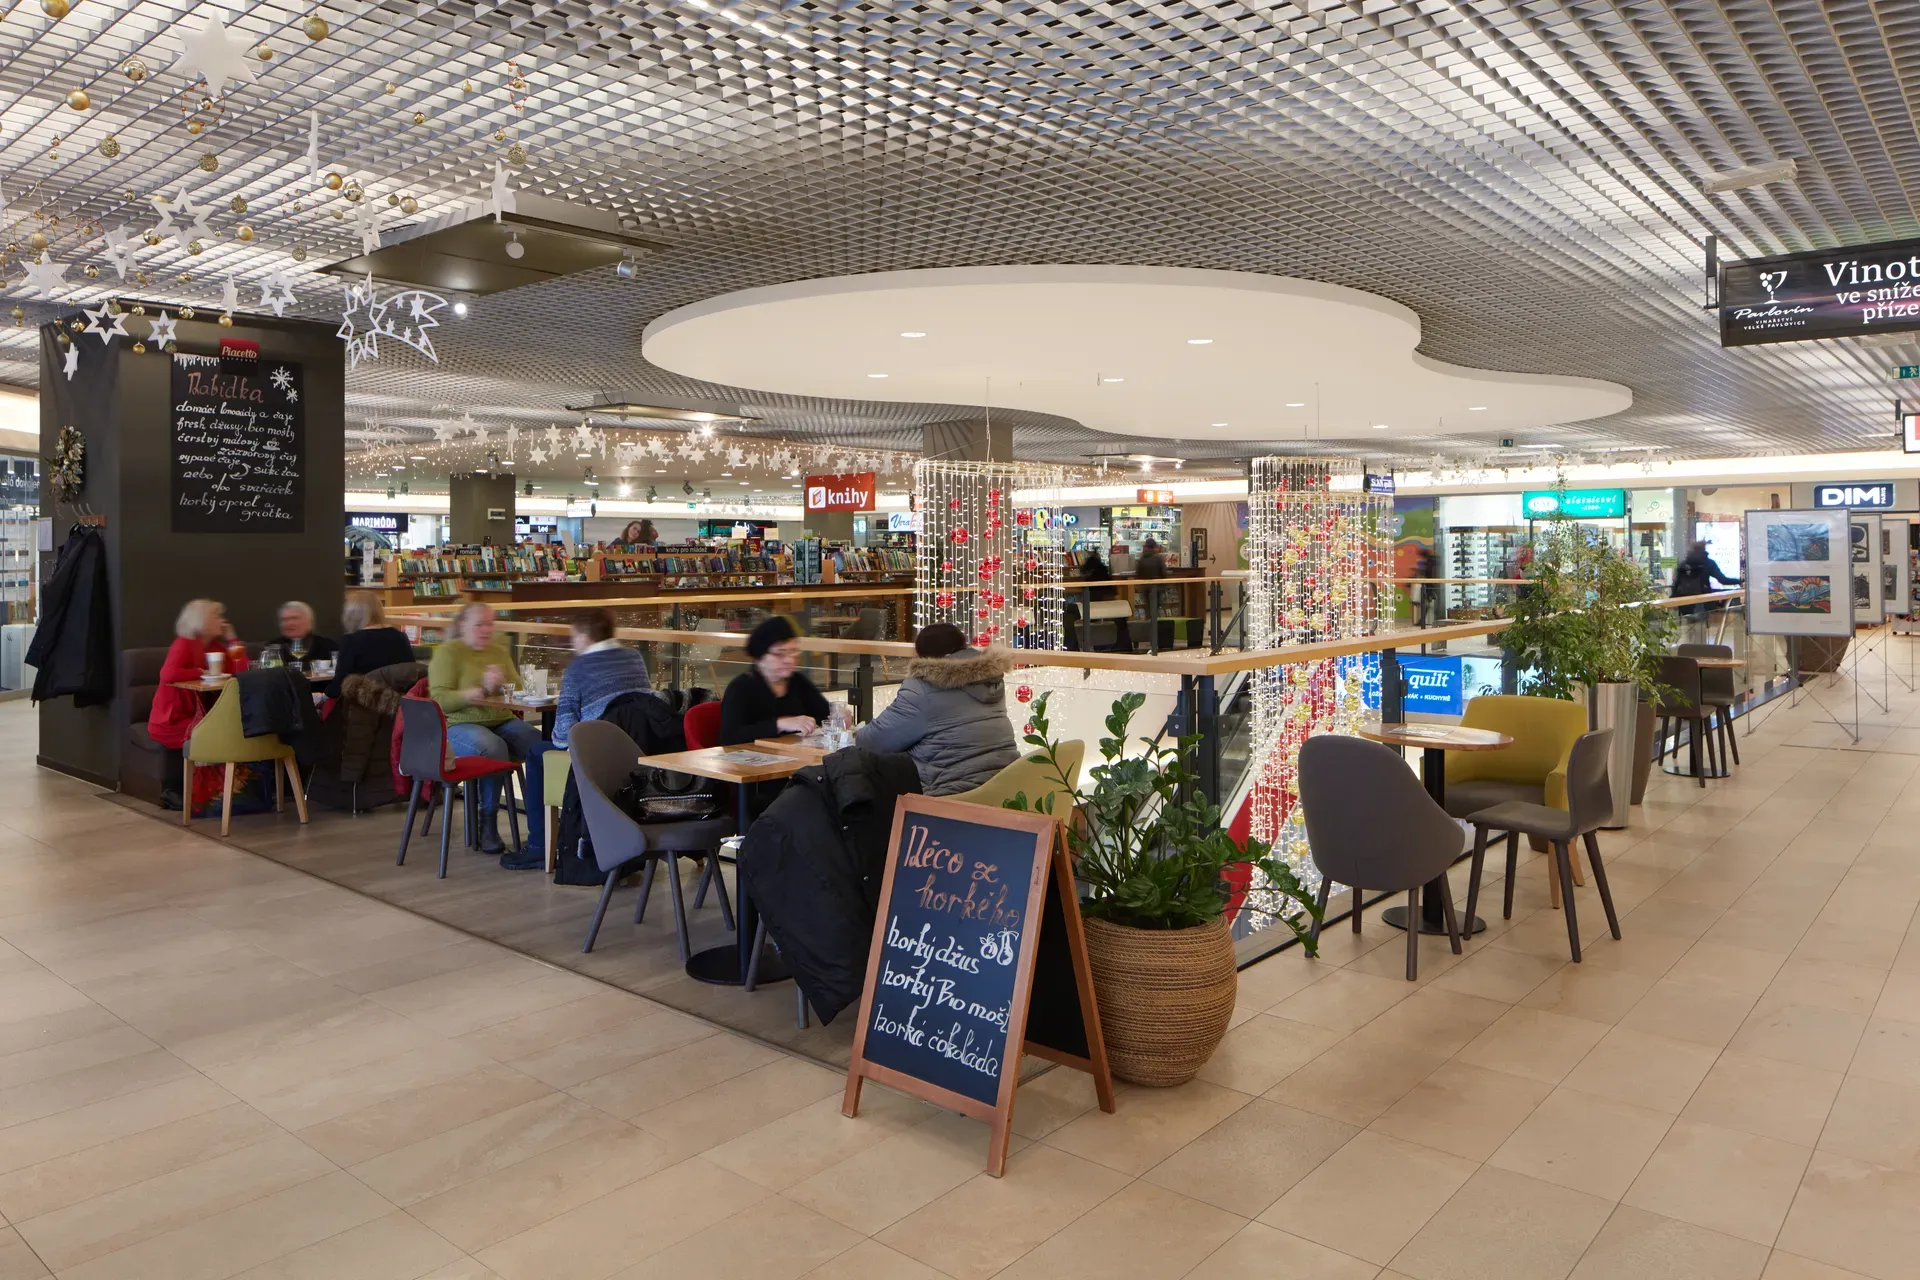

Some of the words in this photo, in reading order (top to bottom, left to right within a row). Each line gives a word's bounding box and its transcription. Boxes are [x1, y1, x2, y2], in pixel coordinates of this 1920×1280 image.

[1822, 256, 1920, 286] Vinot
[1836, 290, 1860, 304] ve
[1867, 280, 1920, 302] sníže
[1862, 300, 1920, 324] příze
[221, 345, 257, 359] Piacetto
[272, 410, 294, 426] čaje
[176, 416, 206, 431] fresh
[248, 421, 265, 432] bio
[267, 424, 294, 443] mošty
[177, 432, 220, 448] čerstvý
[222, 434, 260, 452] mátový
[178, 454, 216, 465] sypané
[218, 456, 241, 469] čaje
[217, 447, 276, 467] zázvorový
[279, 452, 297, 467] čaj
[183, 466, 214, 480] nebo
[240, 480, 294, 495] svařáček
[828, 487, 868, 508] knihy
[1821, 486, 1880, 506] DIM
[180, 492, 216, 515] horký
[240, 508, 294, 522] griotka
[460, 548, 479, 556] romány
[665, 546, 680, 554] knihy
[1408, 672, 1450, 689] quilt
[904, 824, 964, 874] Něco
[971, 861, 1000, 883] z
[914, 873, 1020, 928] horkého
[886, 915, 936, 968] horký
[935, 936, 980, 974] džus
[882, 960, 936, 1010] horký
[936, 978, 966, 1010] Bio
[874, 1004, 926, 1047] horká
[928, 1022, 998, 1078] čokoláda
